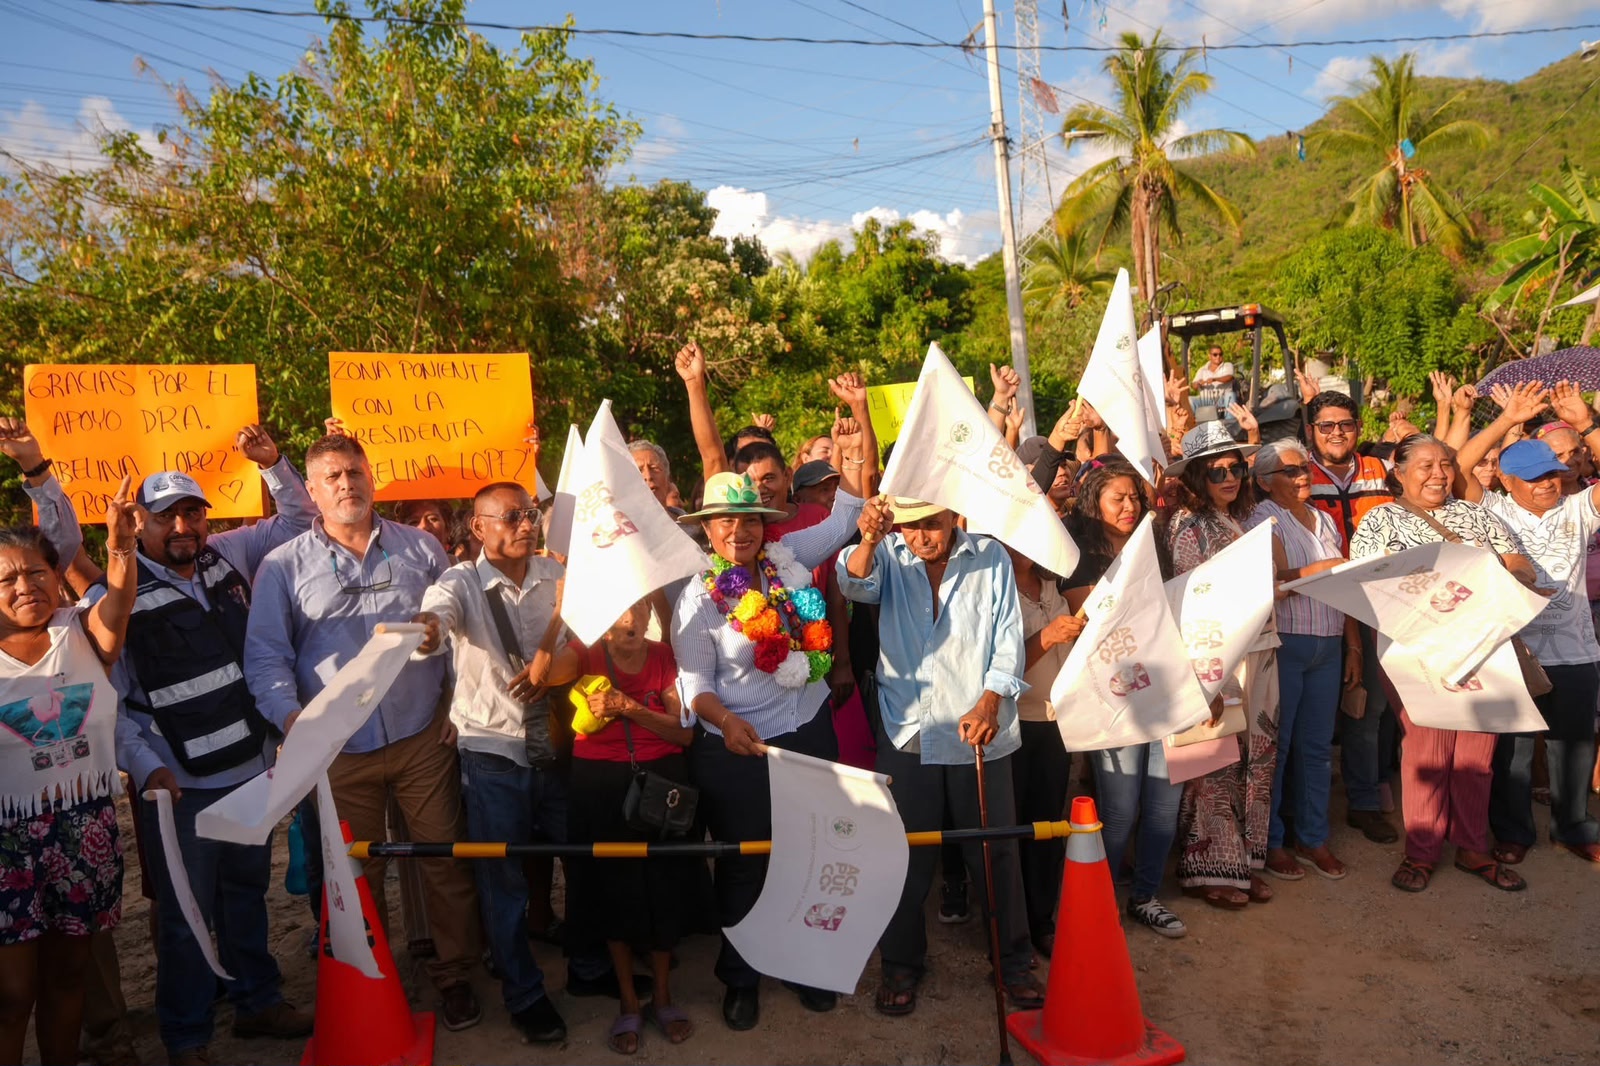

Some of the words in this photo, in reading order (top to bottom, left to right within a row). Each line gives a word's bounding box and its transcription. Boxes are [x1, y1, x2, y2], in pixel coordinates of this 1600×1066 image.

[28, 370, 136, 399] GRACIAS
[148, 369, 195, 397] POR
[208, 370, 241, 396] EL
[333, 360, 392, 382] ZONA
[398, 360, 501, 383] PONIENTE
[352, 397, 393, 416] CON
[414, 391, 445, 411] LA
[54, 408, 122, 436] APOYO
[141, 404, 211, 434] DRA.
[1119, 627, 1138, 657] ACA
[829, 862, 848, 895] PUL
[841, 864, 861, 897] ACA
